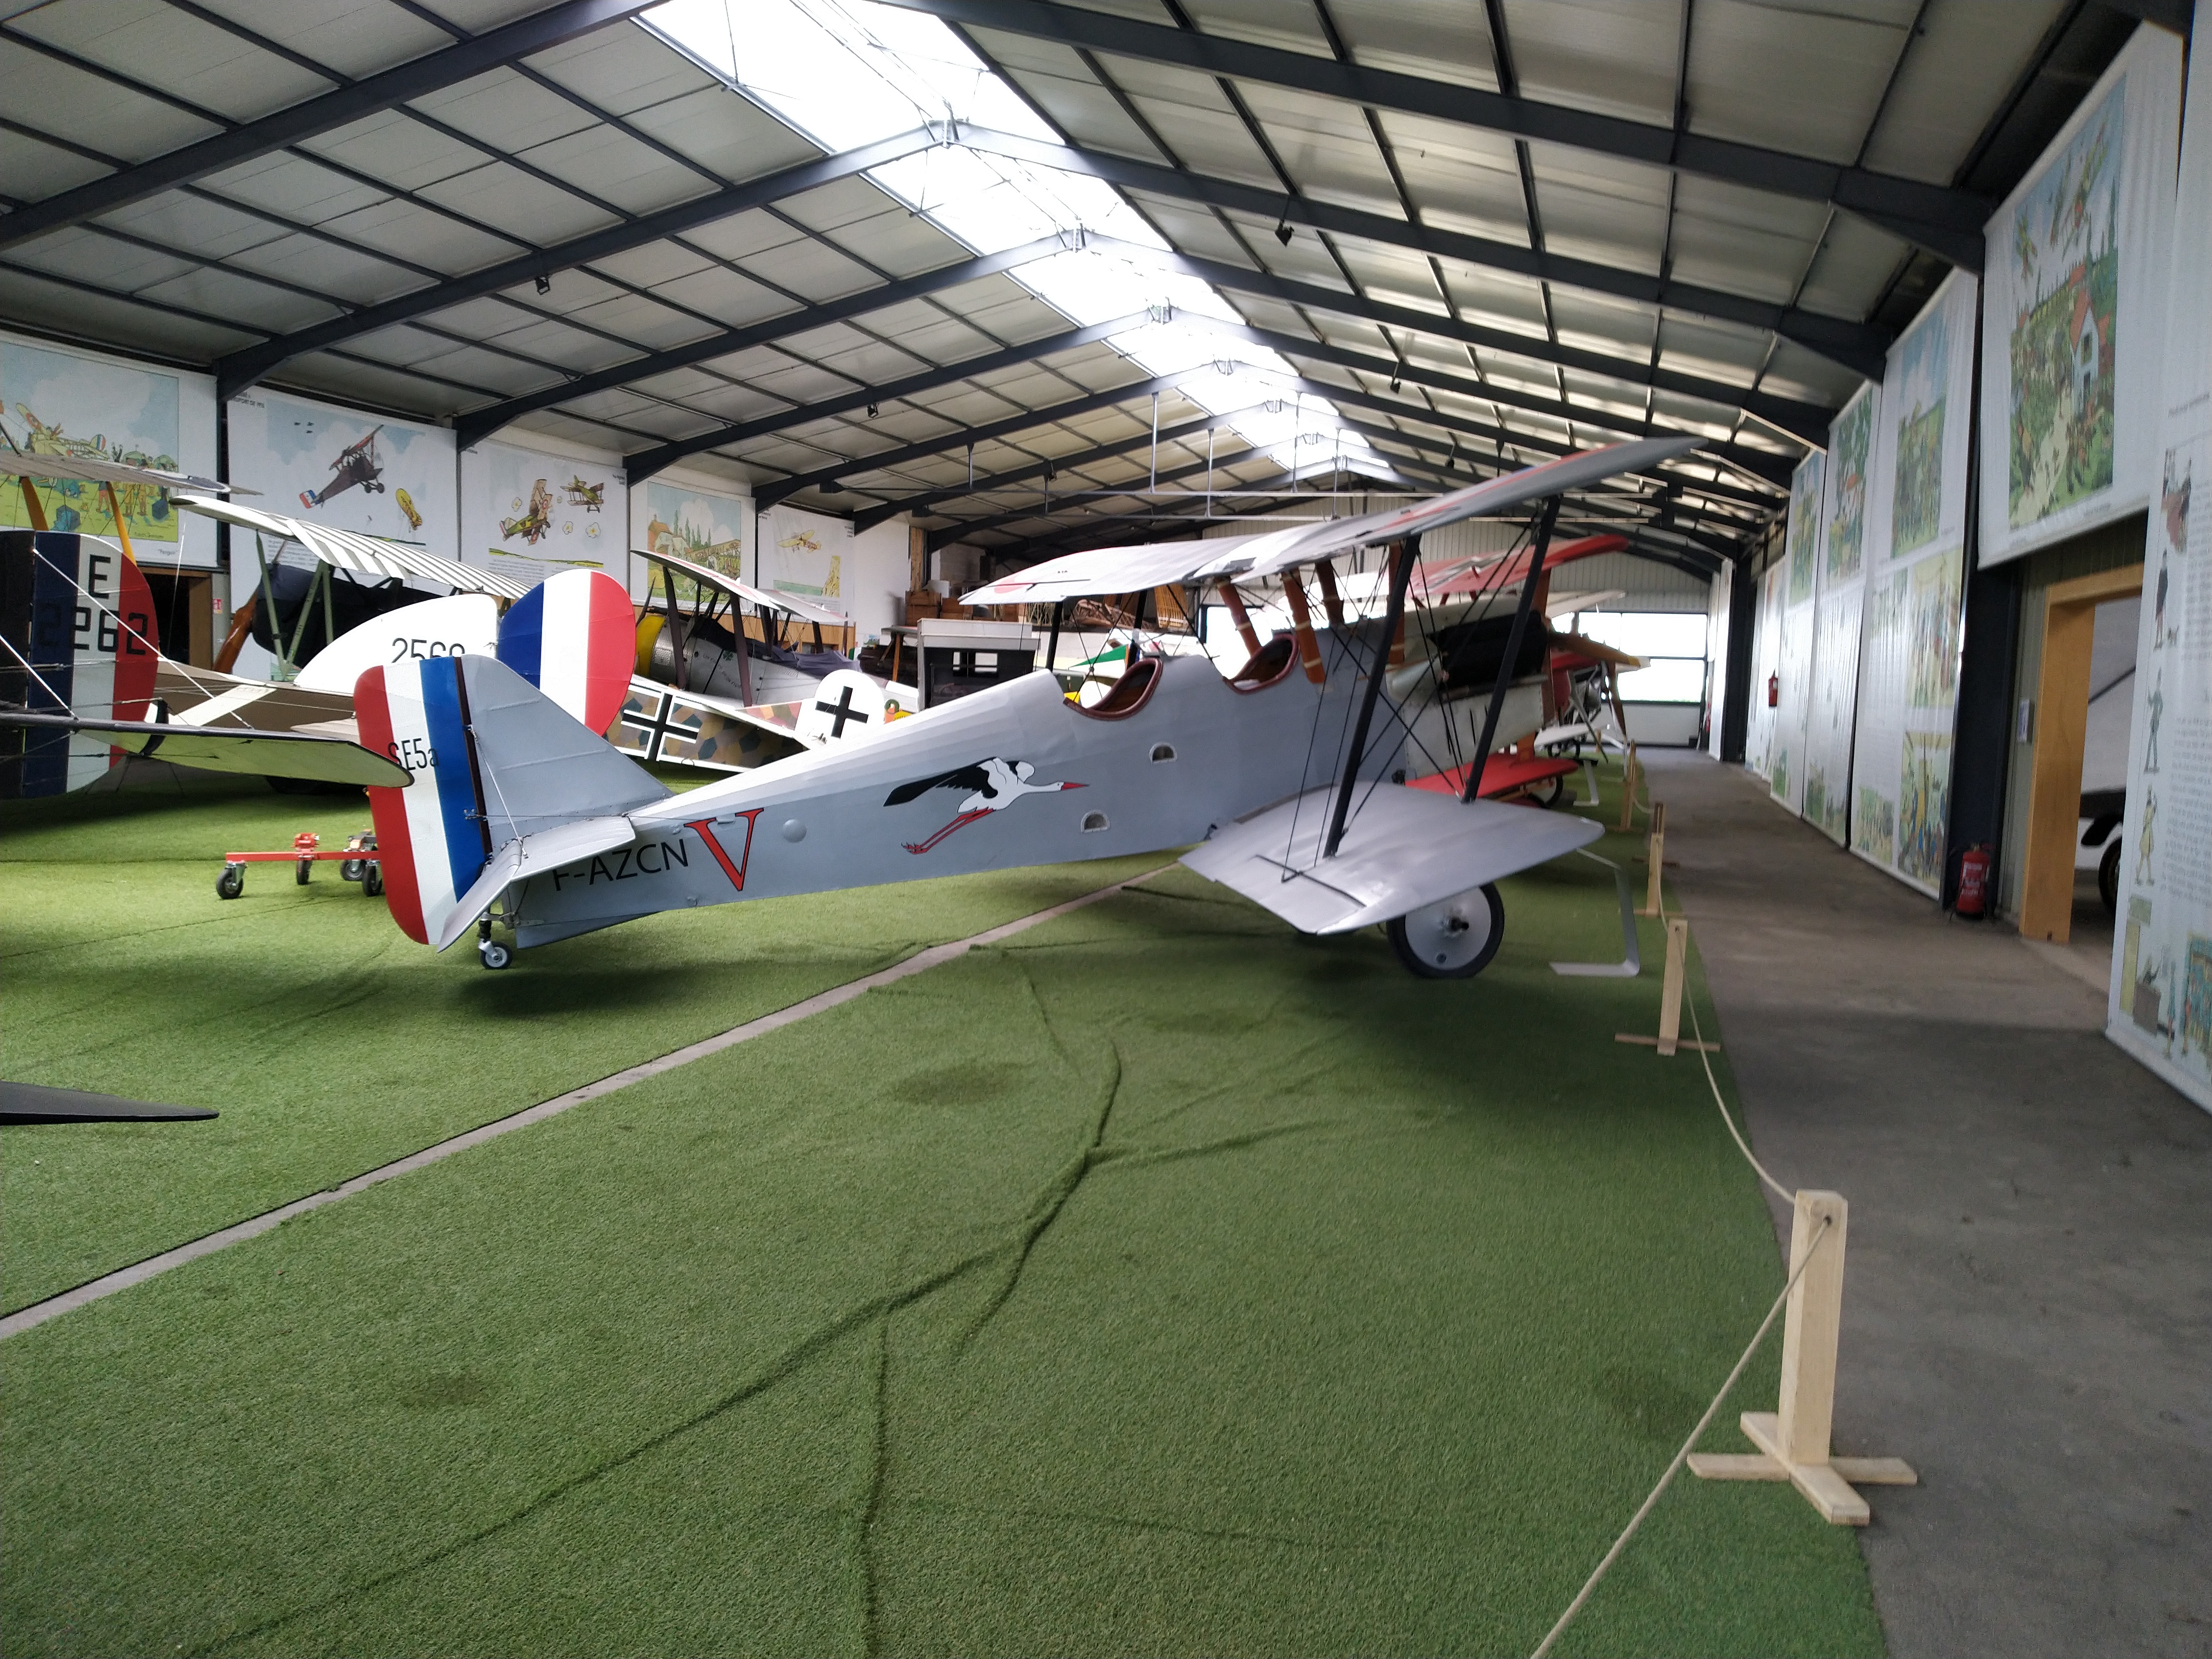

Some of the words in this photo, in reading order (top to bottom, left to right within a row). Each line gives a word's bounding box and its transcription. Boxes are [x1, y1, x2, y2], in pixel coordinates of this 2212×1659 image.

[88, 553, 111, 600] E
[387, 737, 439, 771] SE5a
[553, 838, 689, 892] F-AZCN
[684, 807, 764, 891] V
